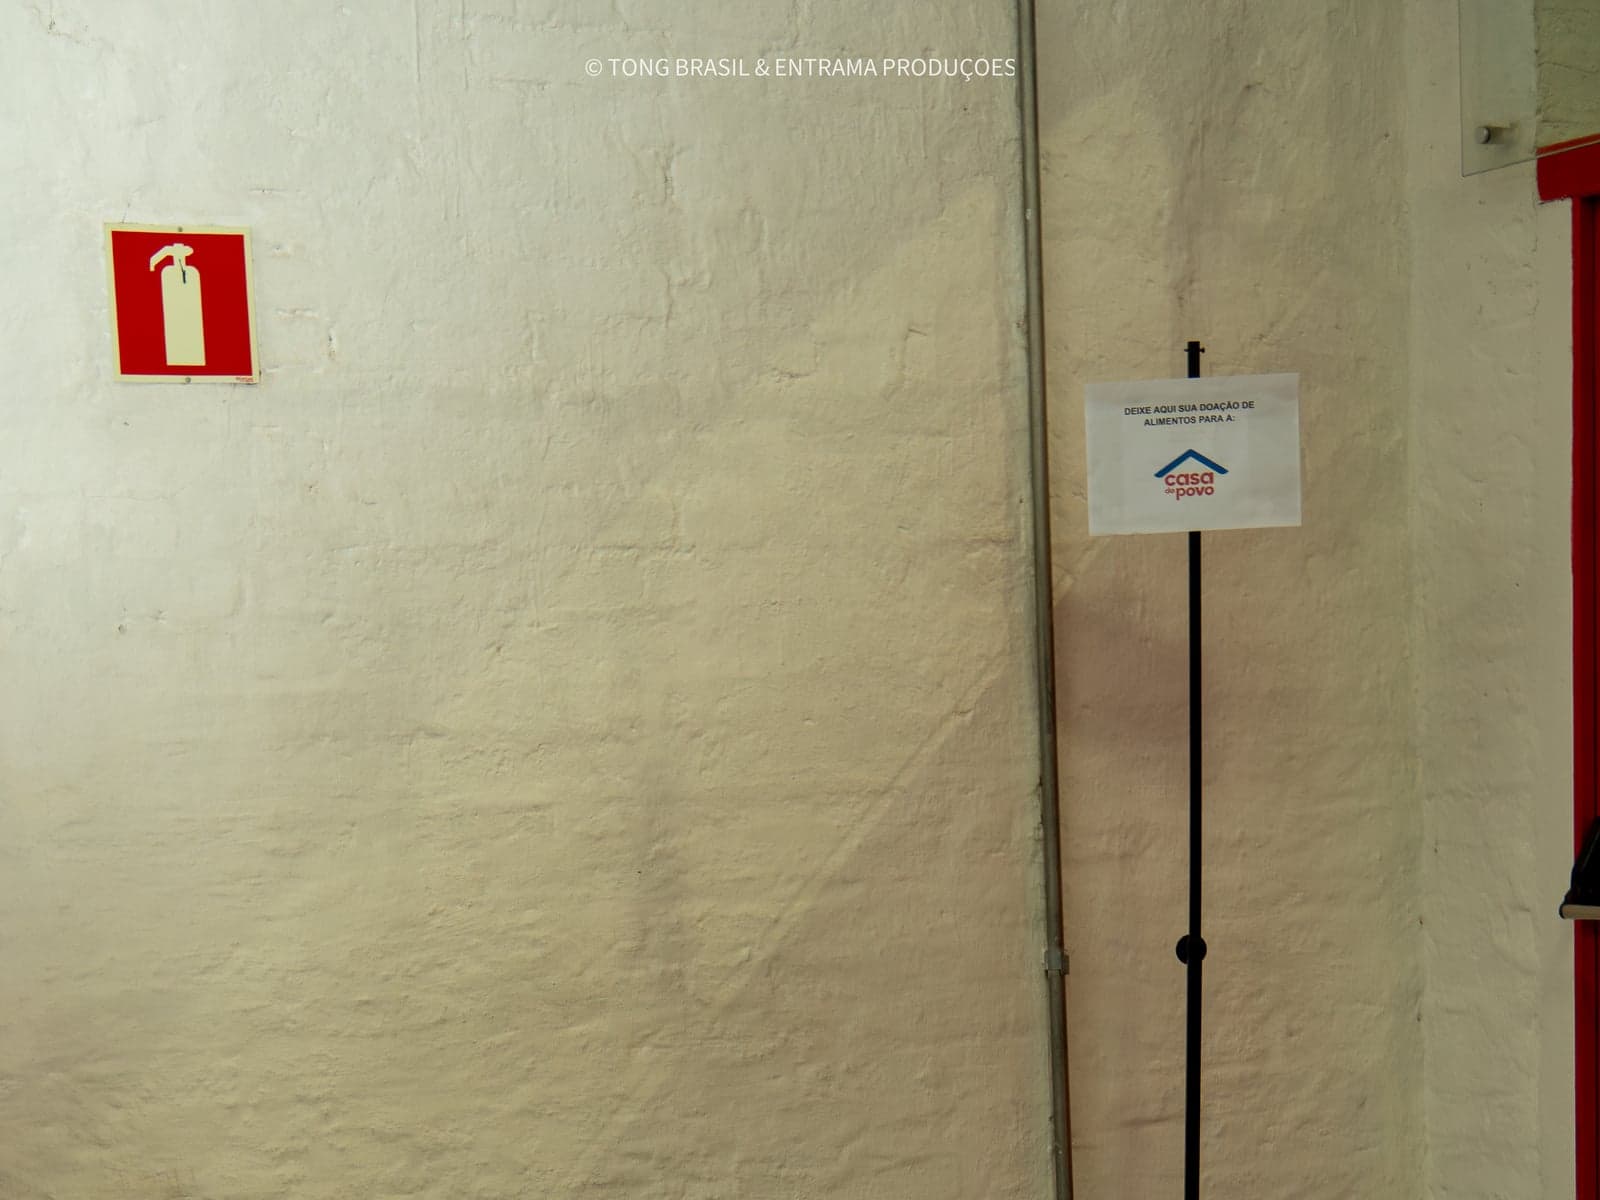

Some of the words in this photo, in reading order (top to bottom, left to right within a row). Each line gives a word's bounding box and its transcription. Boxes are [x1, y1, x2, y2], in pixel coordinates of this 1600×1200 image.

[1124, 406, 1151, 415] DEIXE
[1153, 405, 1177, 414] AQUI
[1178, 404, 1197, 413] SUA
[1199, 401, 1240, 412] DOAÇÃO
[1241, 400, 1255, 409] DE
[1144, 416, 1196, 426] ALIMENTOS
[1198, 414, 1224, 423] PARA
[1164, 471, 1214, 486] casa
[1175, 486, 1214, 500] povo
